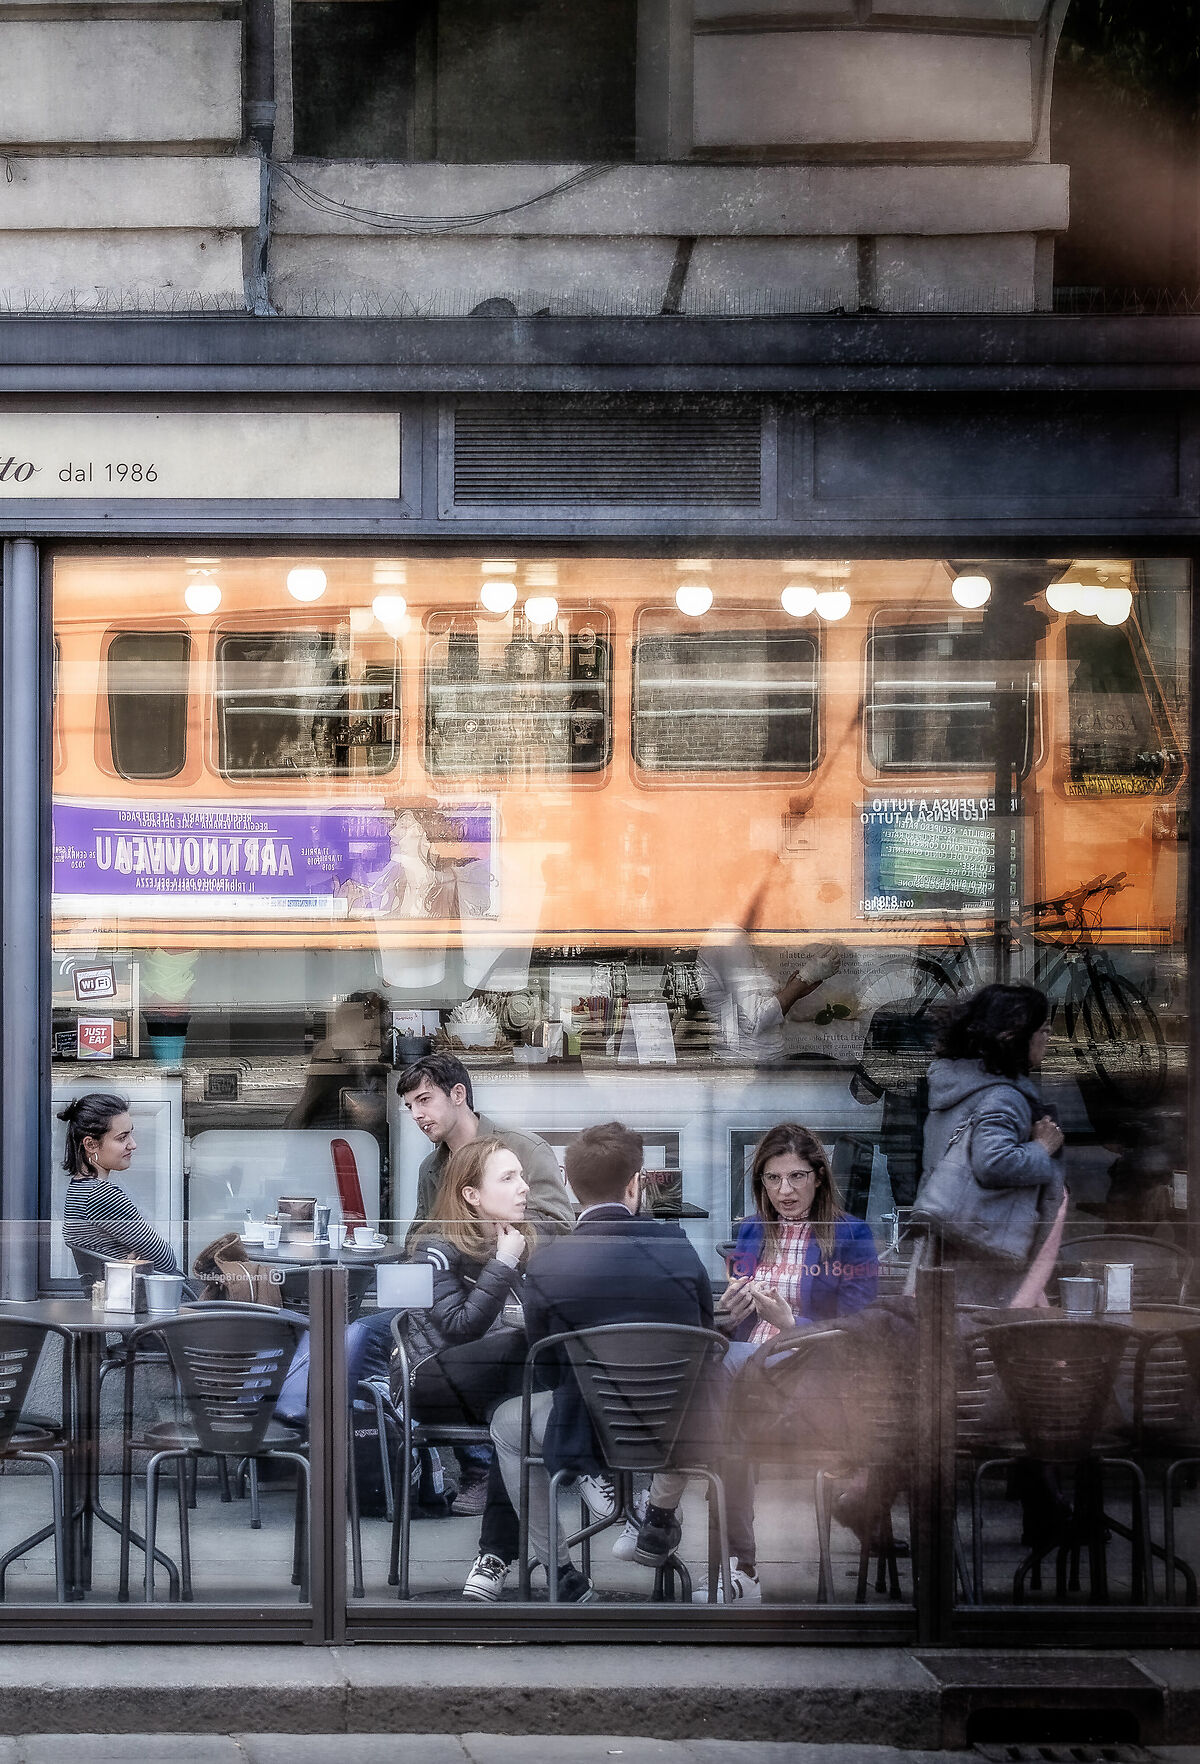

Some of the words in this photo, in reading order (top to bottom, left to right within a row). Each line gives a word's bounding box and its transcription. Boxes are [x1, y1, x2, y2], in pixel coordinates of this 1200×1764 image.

[58, 463, 93, 483] dal
[104, 463, 158, 483] 1986
[84, 1027, 107, 1037] JUST
[89, 1036, 107, 1044] EAT
[823, 1033, 849, 1041] frutta
